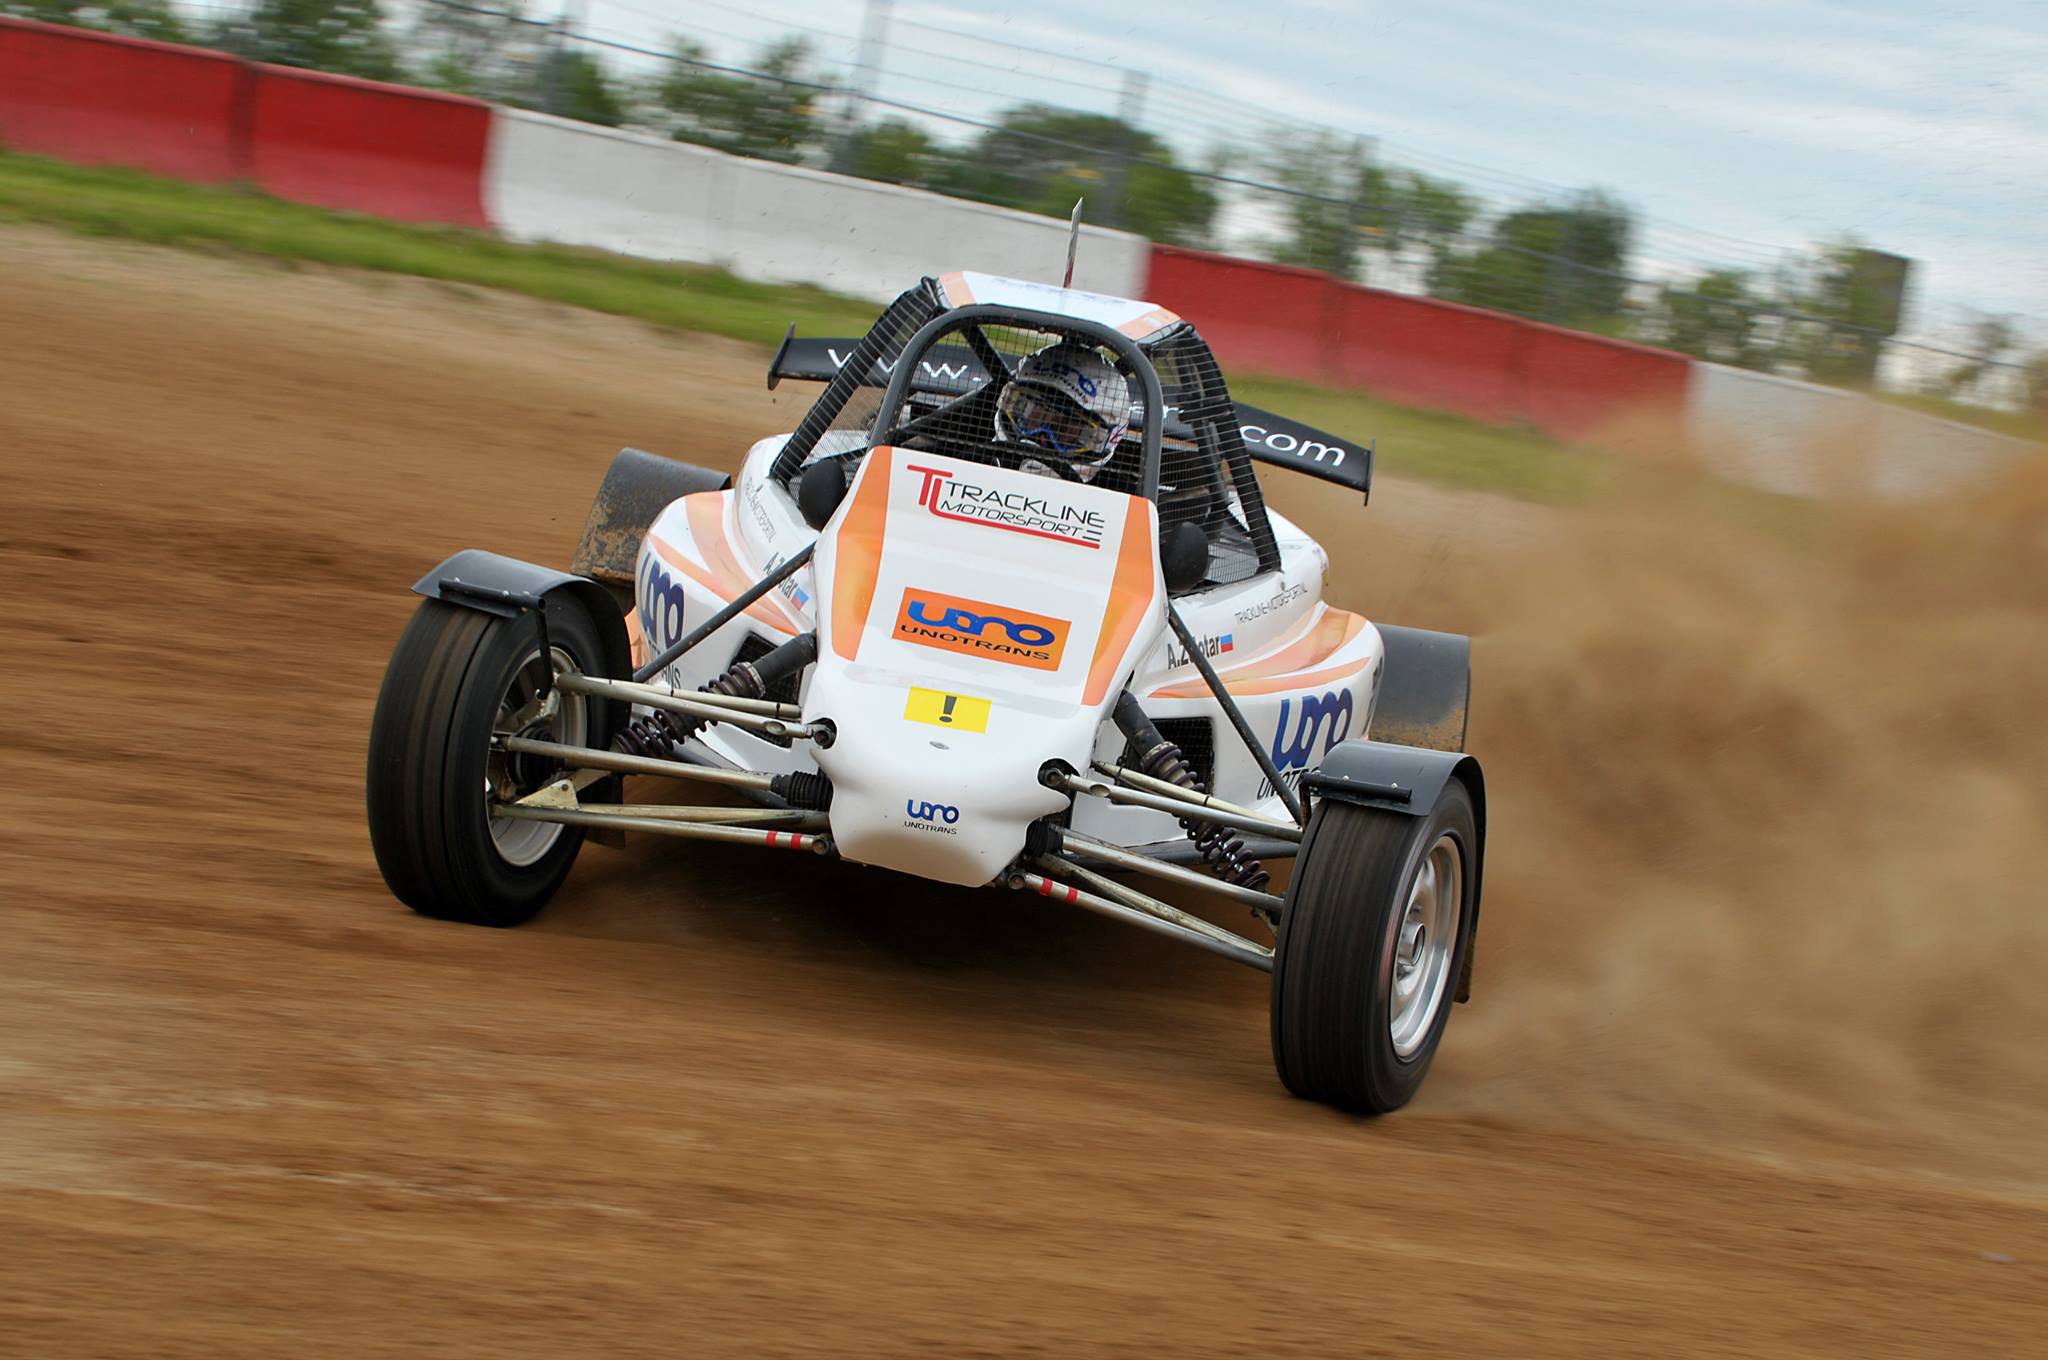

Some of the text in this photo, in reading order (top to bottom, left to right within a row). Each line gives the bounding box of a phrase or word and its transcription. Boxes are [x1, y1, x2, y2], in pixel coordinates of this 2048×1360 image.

[946, 480, 1105, 529] TRACKLINE
[900, 624, 1050, 661] UNOTRANS
[904, 820, 958, 836] UNOTRANS
